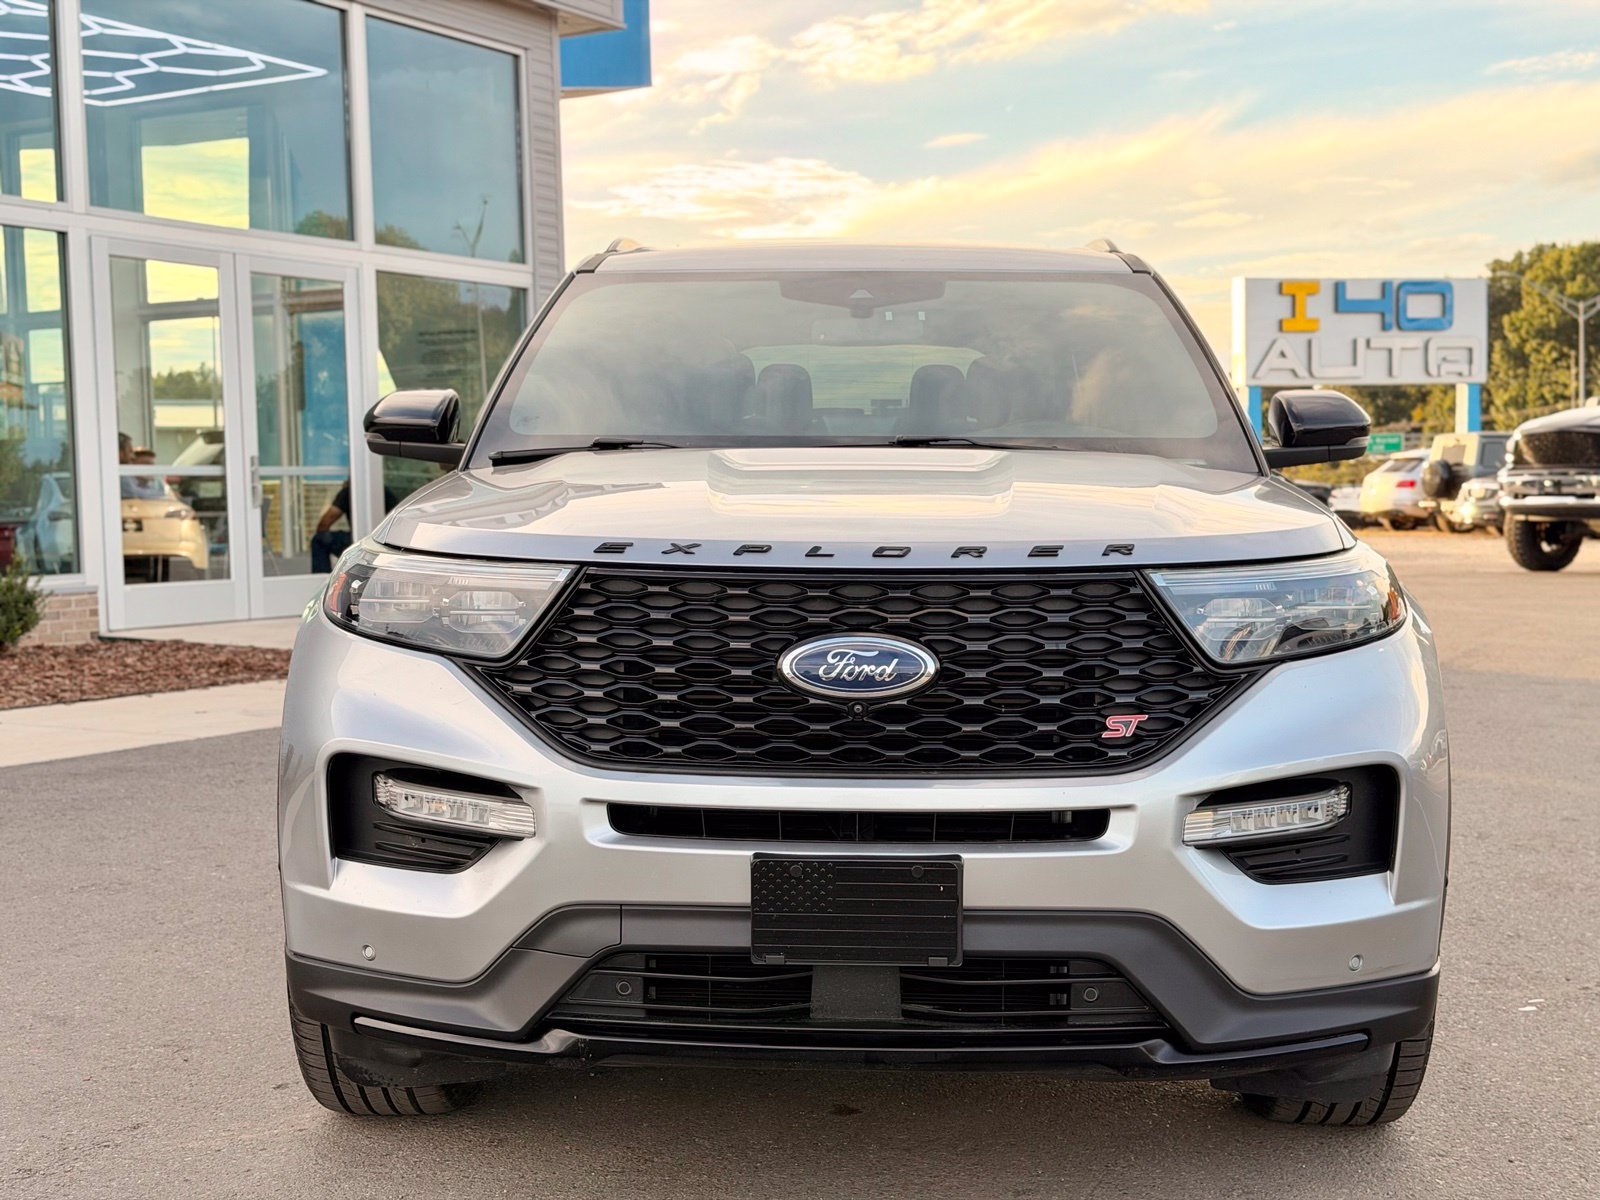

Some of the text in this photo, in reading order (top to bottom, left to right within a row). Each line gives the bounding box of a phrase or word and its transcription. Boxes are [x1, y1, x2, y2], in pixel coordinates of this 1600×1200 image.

[1279, 280, 1455, 332] I 40
[593, 541, 1136, 558] EXPLORER
[818, 648, 899, 681] Ford
[1101, 714, 1149, 738] ST
